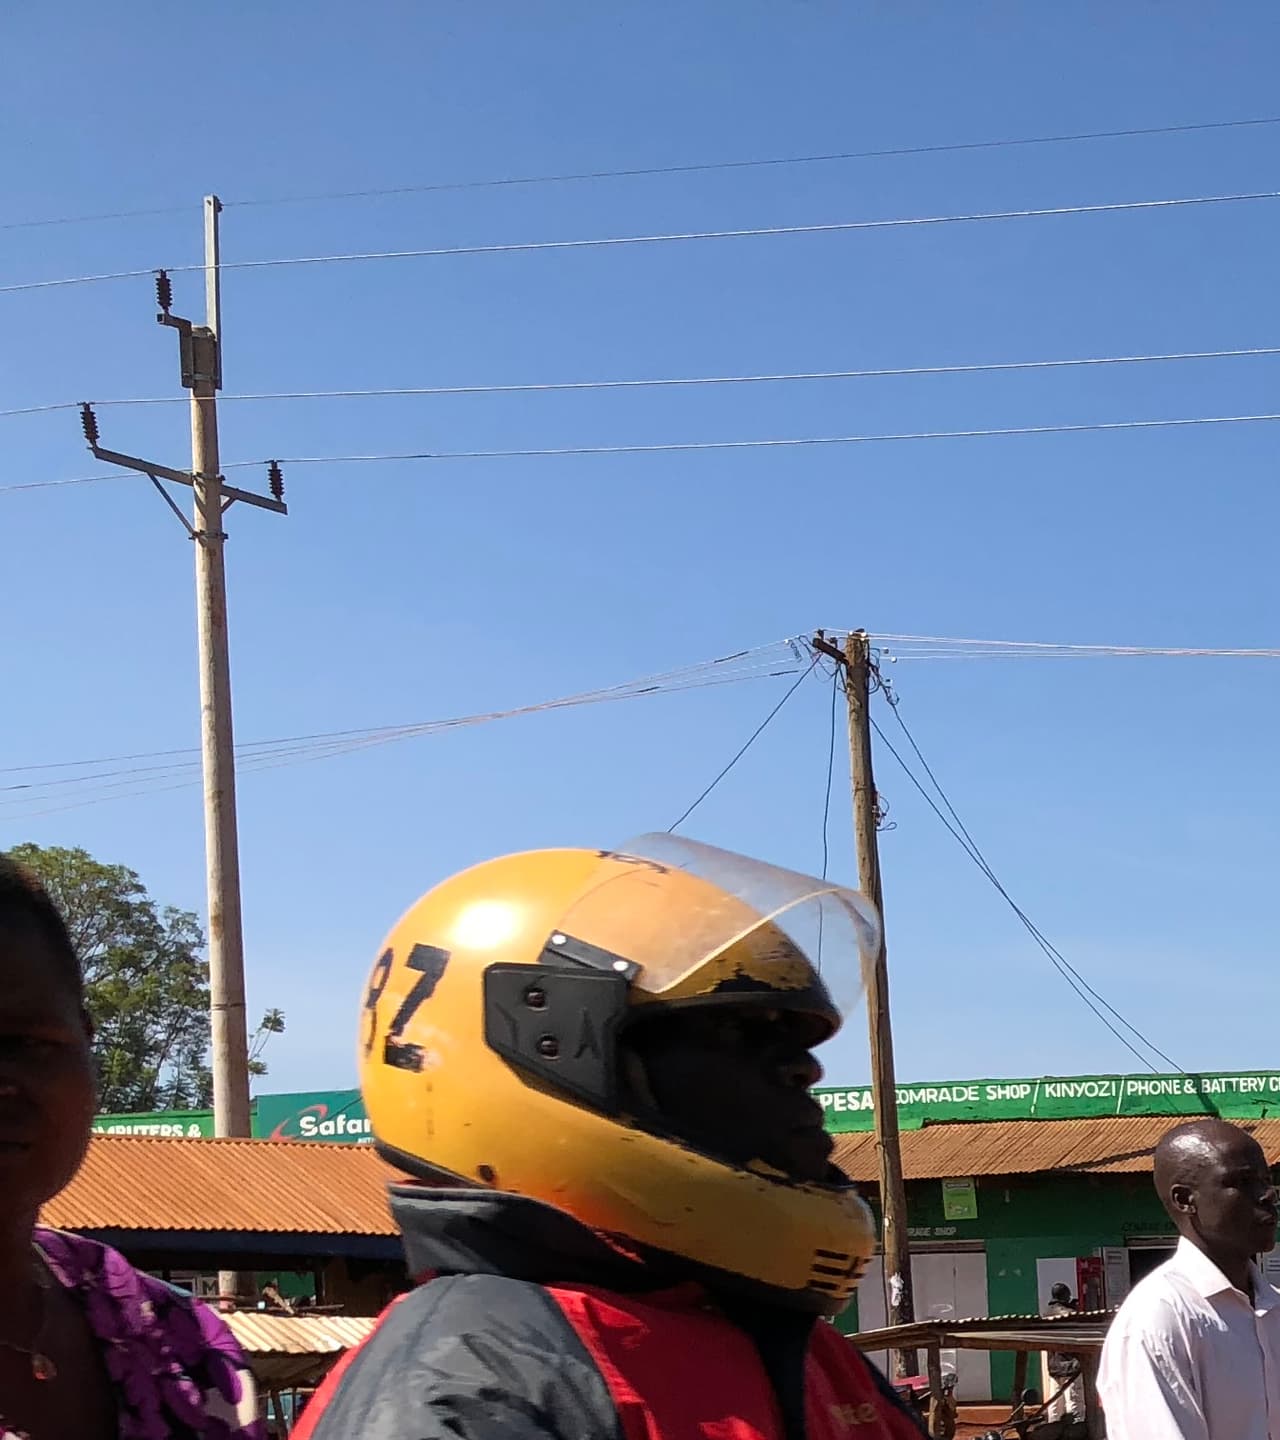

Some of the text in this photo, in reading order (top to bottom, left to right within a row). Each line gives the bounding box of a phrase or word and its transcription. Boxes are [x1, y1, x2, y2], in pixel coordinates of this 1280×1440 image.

[986, 1084, 1031, 1099] SHOP
[1045, 1081, 1116, 1098] KINYOZI
[1127, 1079, 1180, 1096] PHONE
[1184, 1079, 1197, 1094] &
[1201, 1077, 1266, 1093] BATTERY
